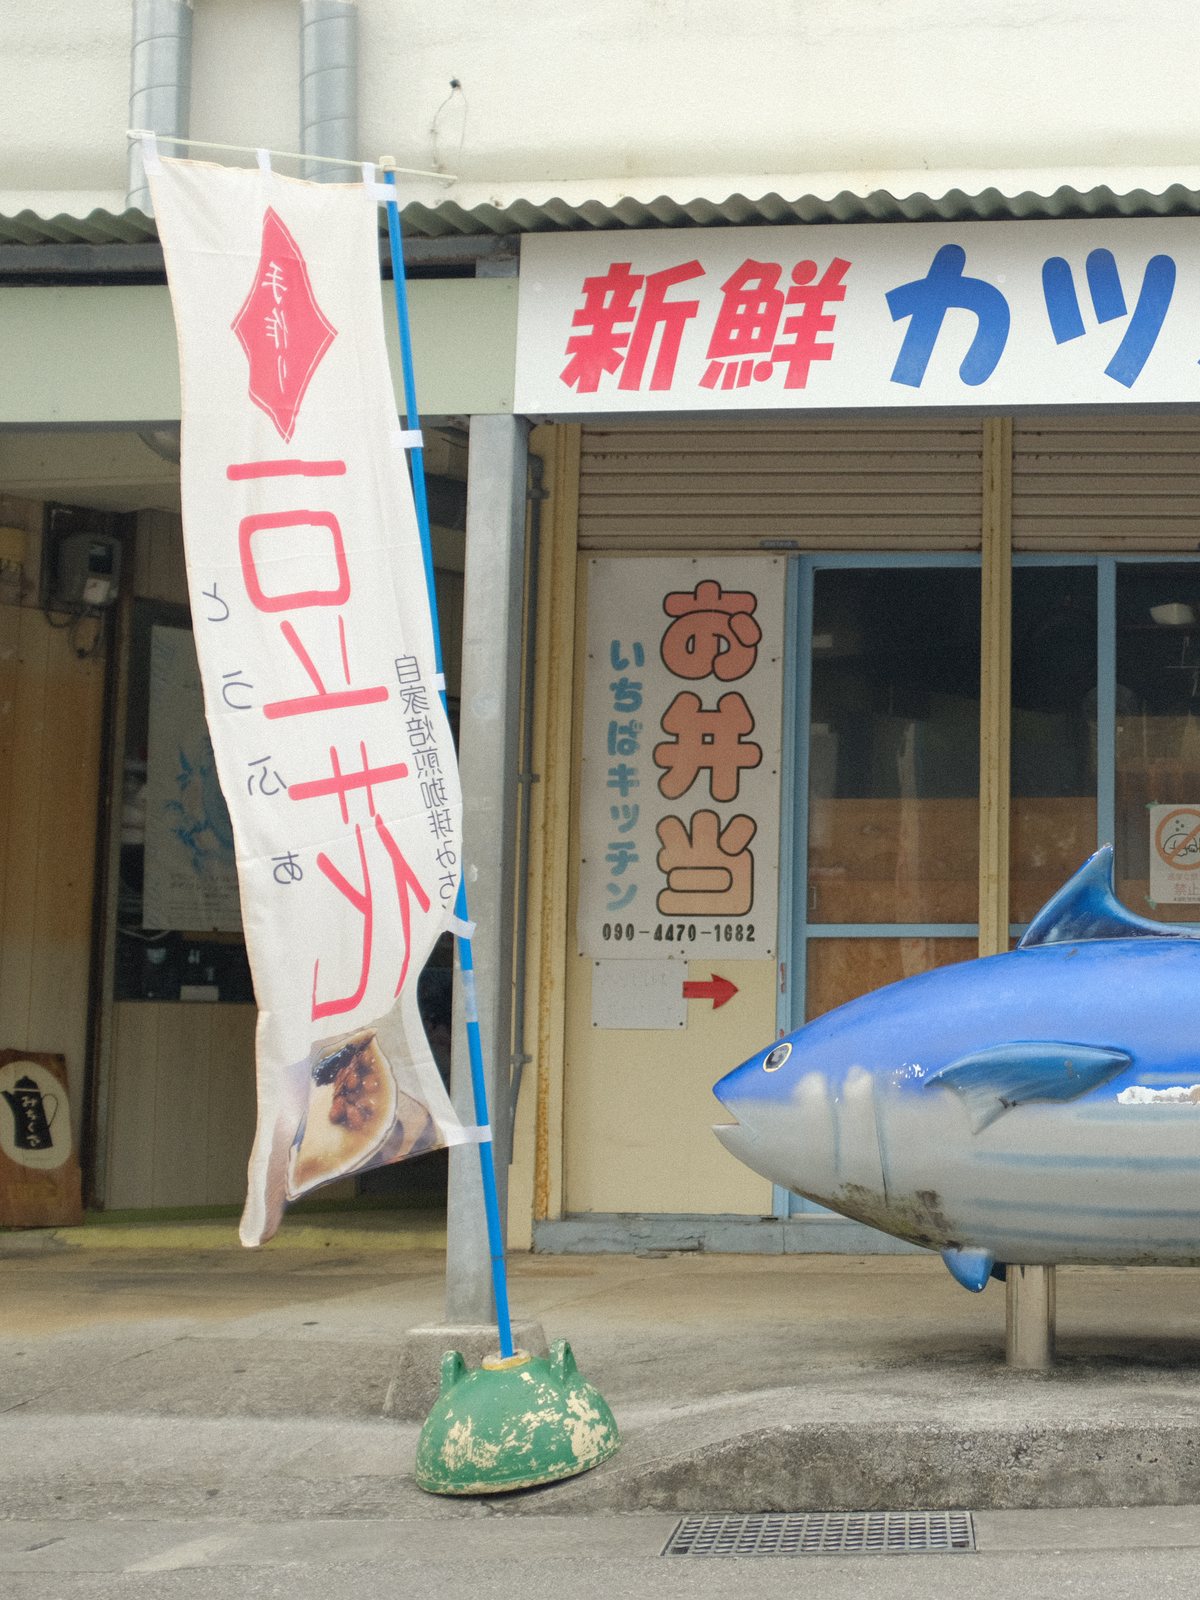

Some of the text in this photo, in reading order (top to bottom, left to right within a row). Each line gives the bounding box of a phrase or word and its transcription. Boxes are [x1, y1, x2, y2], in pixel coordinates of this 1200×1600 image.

[558, 256, 853, 394] 新鮮
[605, 639, 645, 912] いちばキッチン
[653, 579, 763, 917] お弁当
[602, 923, 756, 942] 090-4470-1682
[1174, 883, 1200, 896] 禁止
